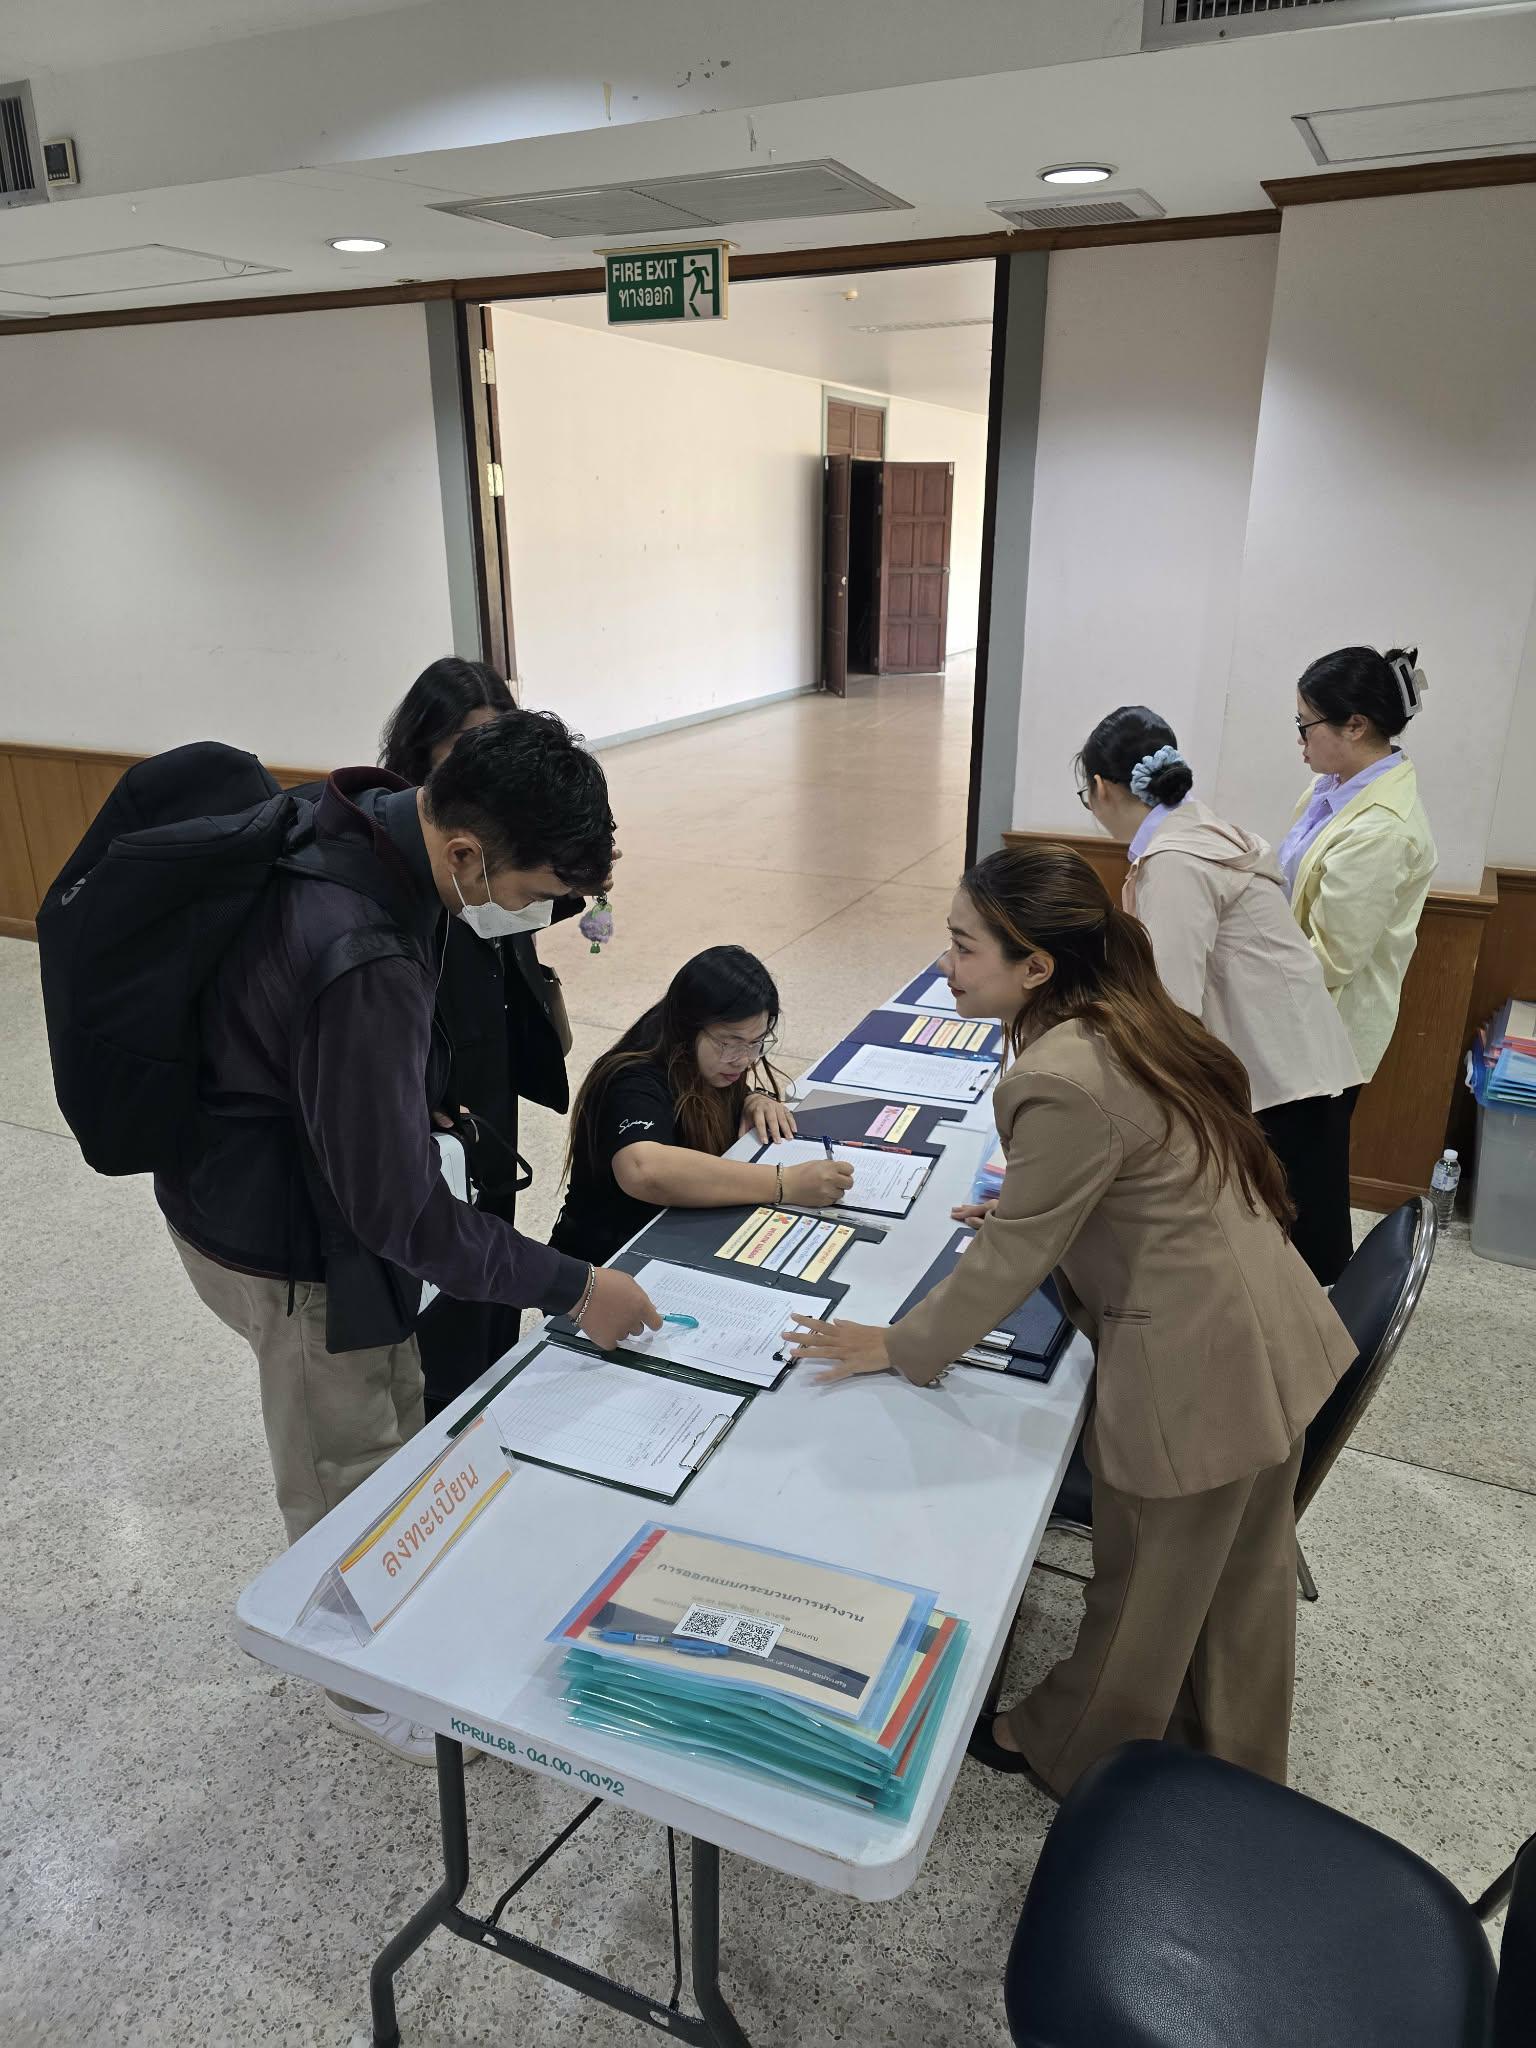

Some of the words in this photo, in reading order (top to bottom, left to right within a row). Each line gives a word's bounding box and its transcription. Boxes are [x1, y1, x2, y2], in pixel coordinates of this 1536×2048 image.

[612, 261, 642, 283] FIRE
[646, 258, 678, 281] EXIT
[618, 285, 673, 308] ทางออก
[382, 1464, 479, 1577] ลงทะเบียน
